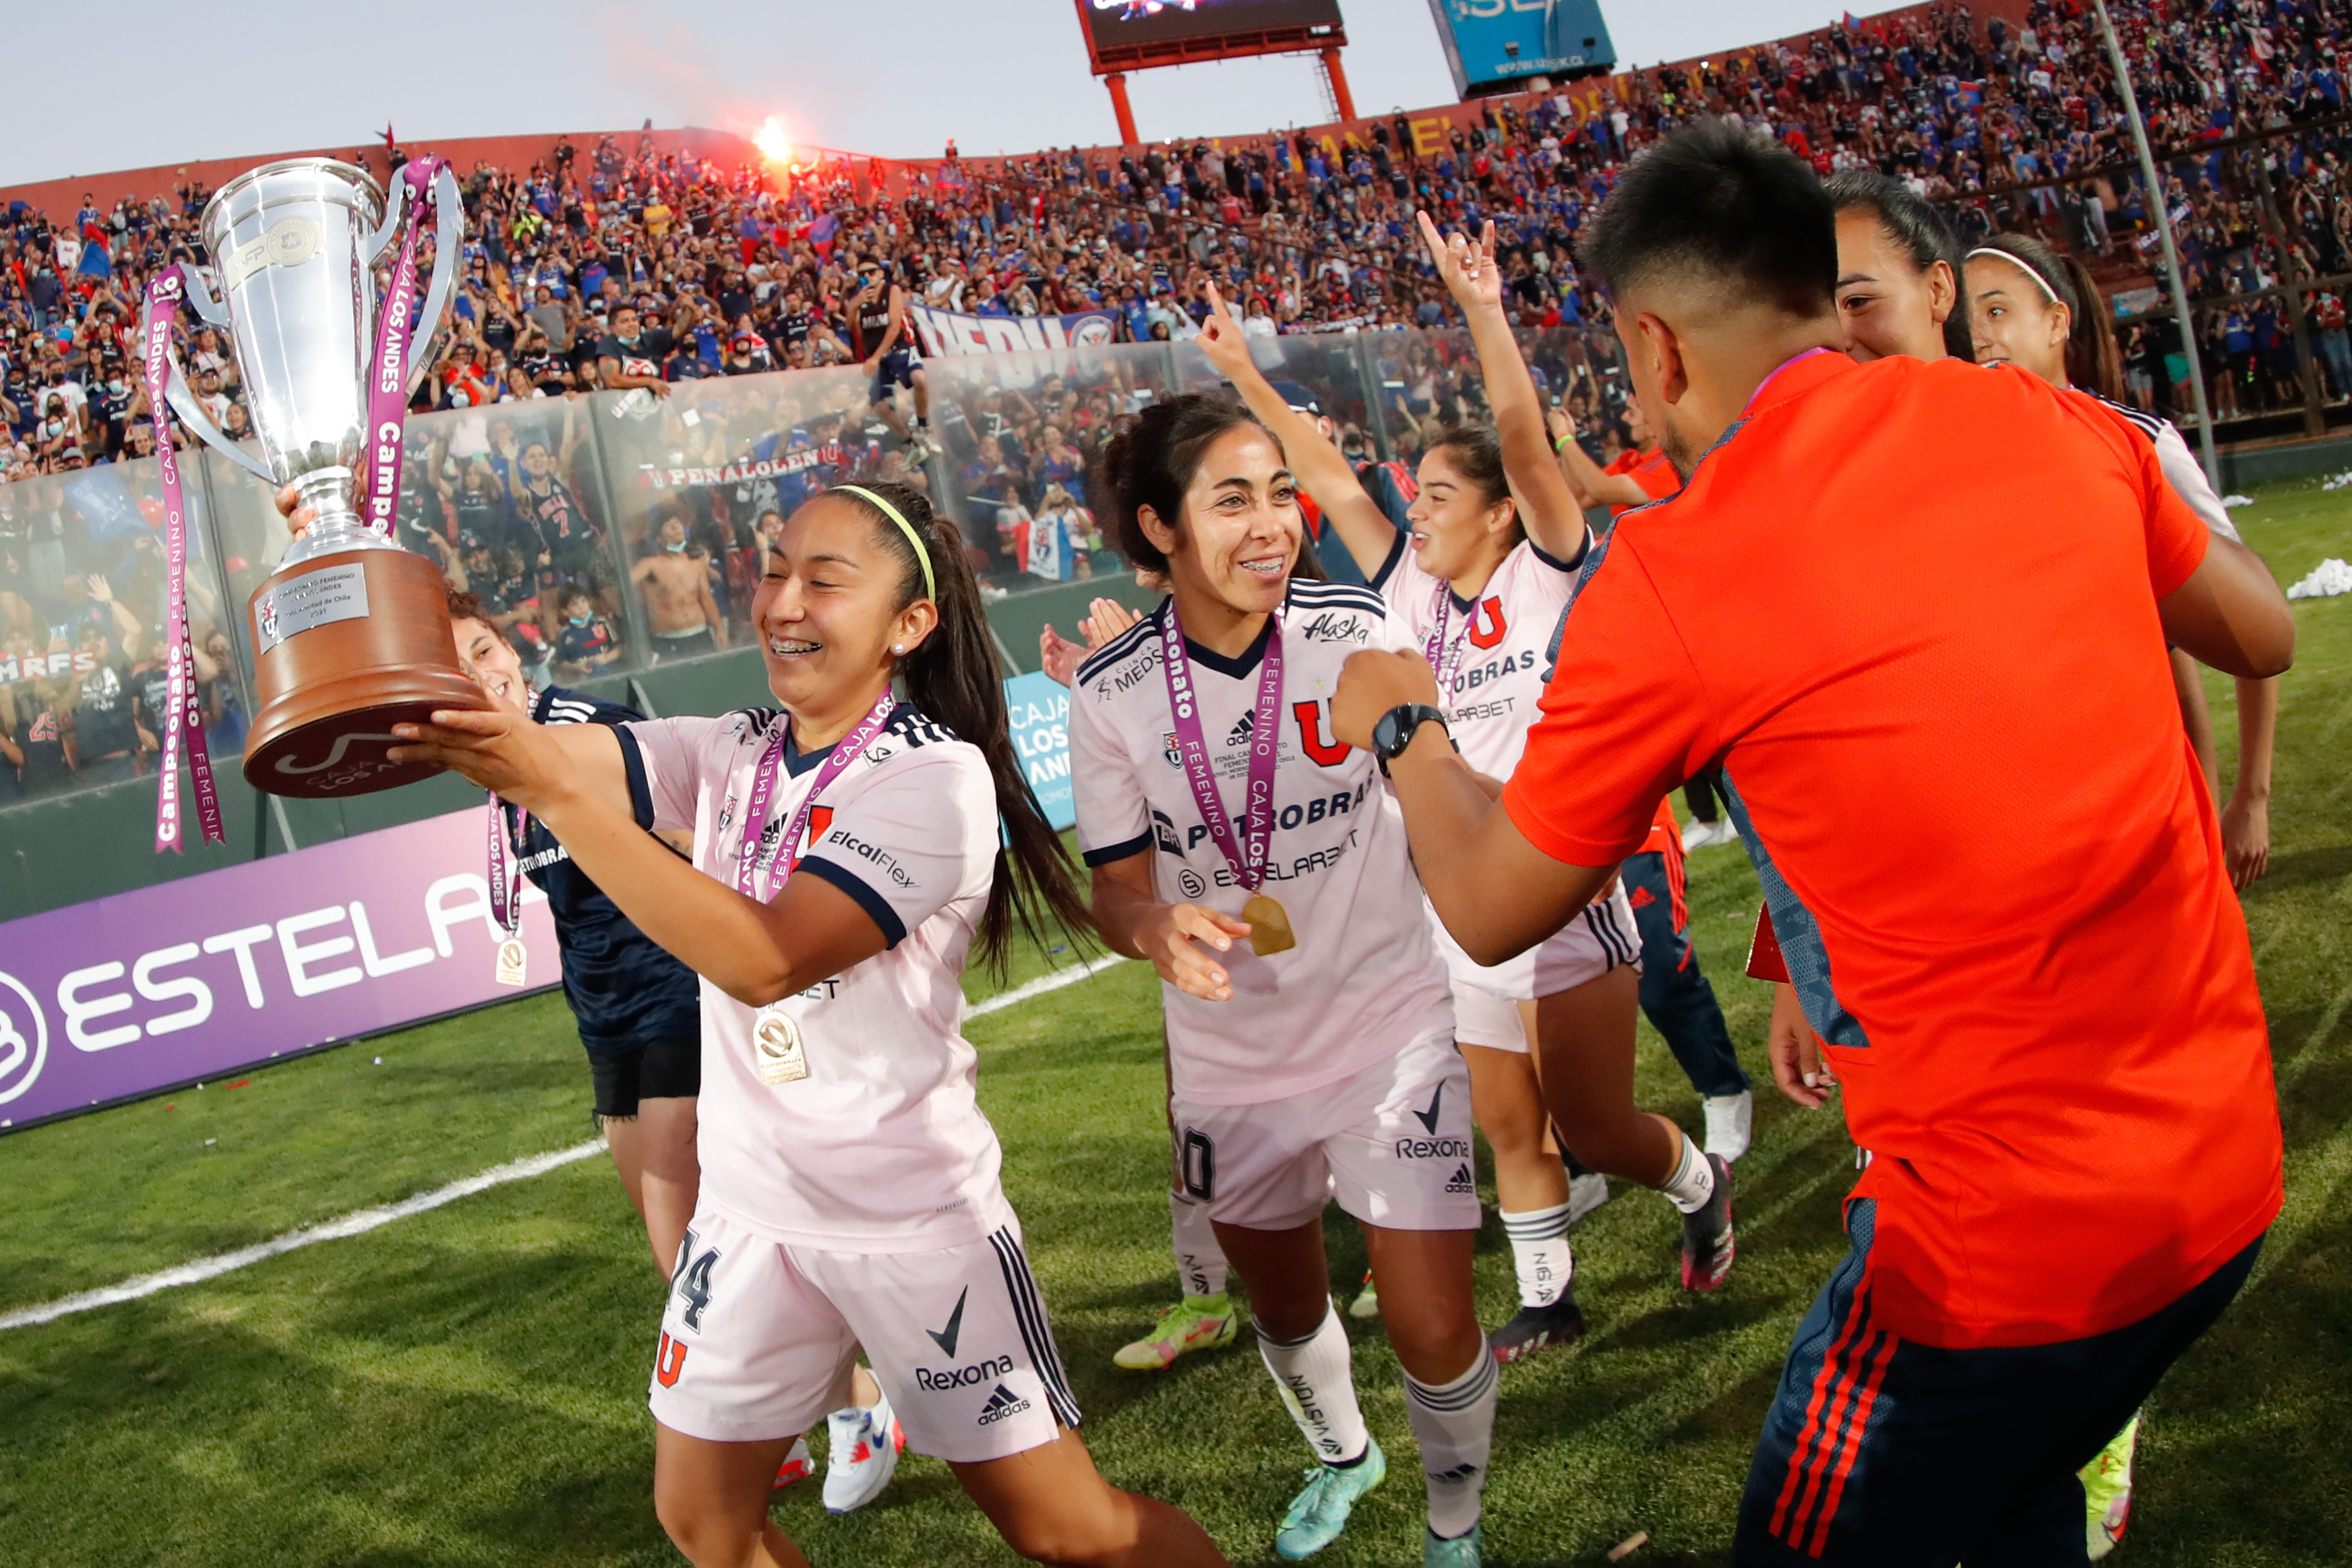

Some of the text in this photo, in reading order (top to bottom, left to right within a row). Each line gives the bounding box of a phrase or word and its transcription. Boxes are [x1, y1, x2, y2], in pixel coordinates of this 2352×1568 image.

[381, 240, 414, 394] CAJA LOS ANDES
[149, 320, 168, 387] ANDES
[152, 390, 165, 429] LOS
[159, 429, 175, 485] CAJA
[1302, 613, 1369, 645] Alaska
[1433, 620, 1445, 644] LOS
[1470, 595, 1507, 650] U
[158, 510, 183, 842] Campeonato FEMENINO
[1454, 650, 1536, 694] OBRAS
[832, 726, 874, 767] CAJA
[1018, 724, 1068, 758] LOS
[1163, 605, 1193, 719] peonato
[1186, 740, 1226, 838] FEMENINO
[752, 735, 782, 817] FEMENIN
[1249, 657, 1280, 866] FEMENINO CAJA LOS
[489, 797, 504, 906] CAJA LOS ANDES
[518, 845, 570, 874] ETROBRA
[772, 787, 821, 889] FEMENINO
[828, 831, 922, 888] ElcalFlex
[657, 1332, 688, 1388] U
[915, 1354, 1014, 1392] Rexona
[977, 1397, 1031, 1427] adidas
